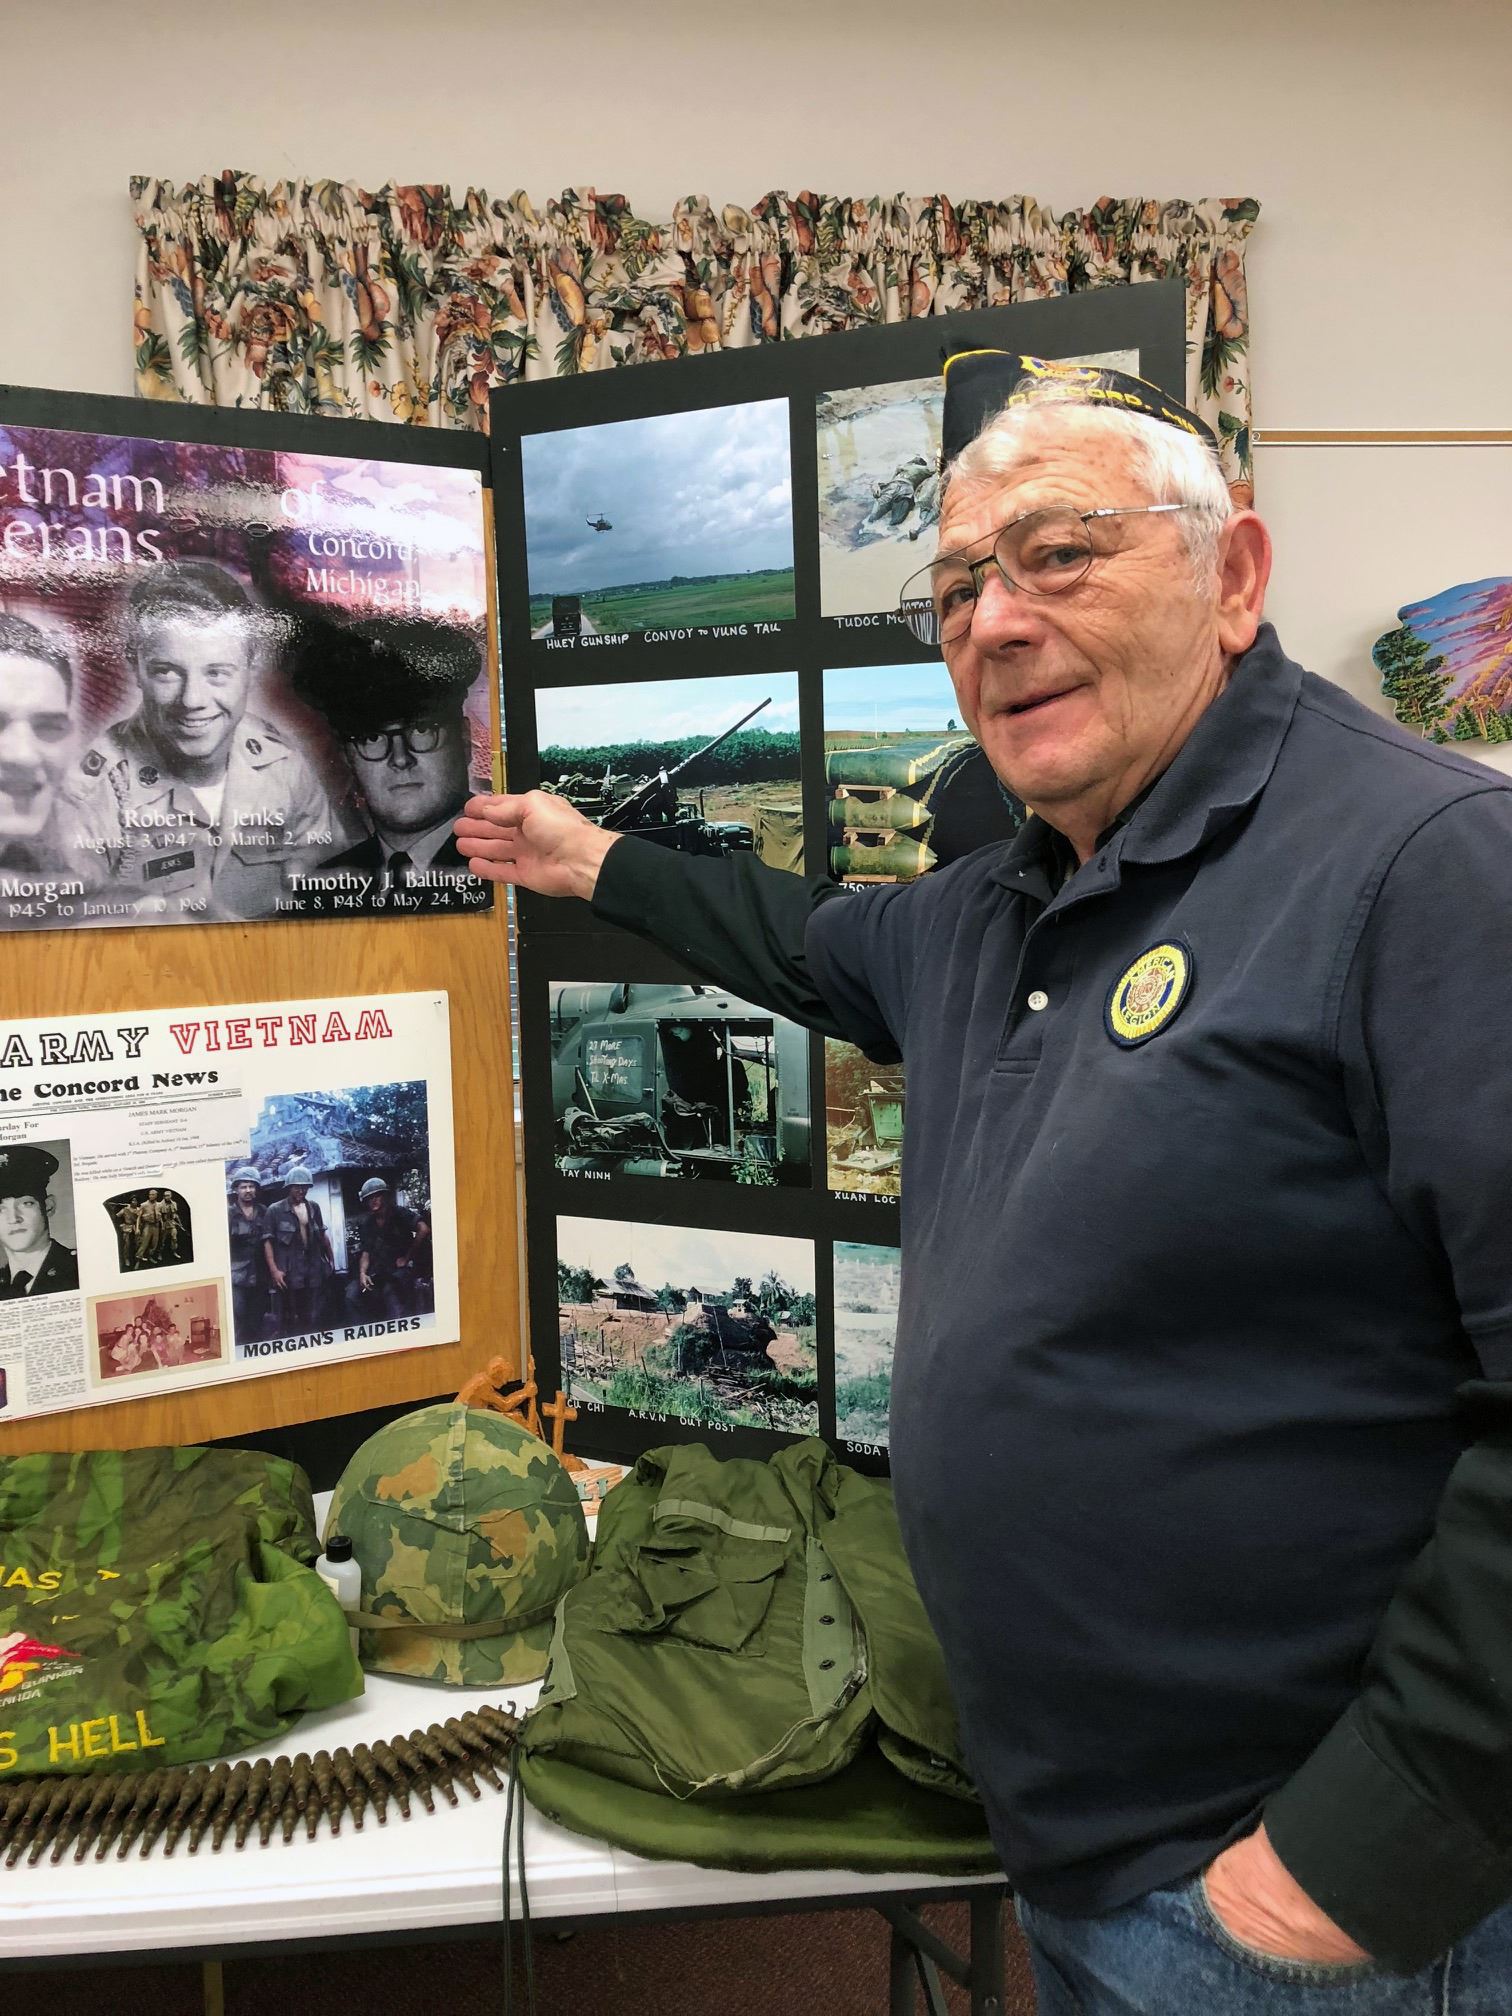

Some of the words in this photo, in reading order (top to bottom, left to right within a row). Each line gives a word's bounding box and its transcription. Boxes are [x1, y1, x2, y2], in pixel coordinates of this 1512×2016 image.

[308, 533, 414, 560] Concord
[306, 567, 420, 605] Michigan
[834, 615, 879, 628] TUDOC
[546, 637, 575, 650] HUEY
[581, 633, 629, 647] GUNSHIP
[644, 628, 694, 643] CONVOY
[712, 624, 748, 638] VUNG
[753, 622, 781, 634] TAU
[124, 809, 196, 828] Robert
[228, 808, 285, 828] Jenks
[73, 834, 132, 853] August
[163, 833, 197, 847] 1947
[207, 834, 222, 847] to
[231, 832, 275, 847] March
[306, 831, 333, 845] 1968
[1, 878, 84, 902] Morgan
[288, 872, 373, 896] Timothy
[381, 872, 395, 892] J.
[405, 870, 483, 892] Ballinger
[9, 903, 47, 917] 1945
[57, 902, 74, 916] to
[84, 902, 143, 919] January
[180, 898, 207, 911] 1968
[273, 897, 307, 913] June
[334, 894, 363, 908] 1948
[372, 895, 386, 908] to
[393, 893, 423, 911] May
[462, 891, 486, 905] 1969
[0, 1027, 149, 1068] ARMY
[170, 1009, 392, 1054] VIETNAM
[34, 1076, 139, 1099] Concord
[152, 1070, 218, 1088] News
[24, 1121, 39, 1129] For
[561, 1169, 580, 1179] TAY
[584, 1169, 611, 1181] NINH
[834, 1191, 867, 1202] XUAN
[874, 1194, 896, 1204] LOC
[244, 1331, 334, 1358] MORGAN'S
[343, 1317, 421, 1342] RAIDERS
[587, 1402, 605, 1413] CHI
[846, 1441, 881, 1456] SODA
[48, 1709, 165, 1763] HELL
